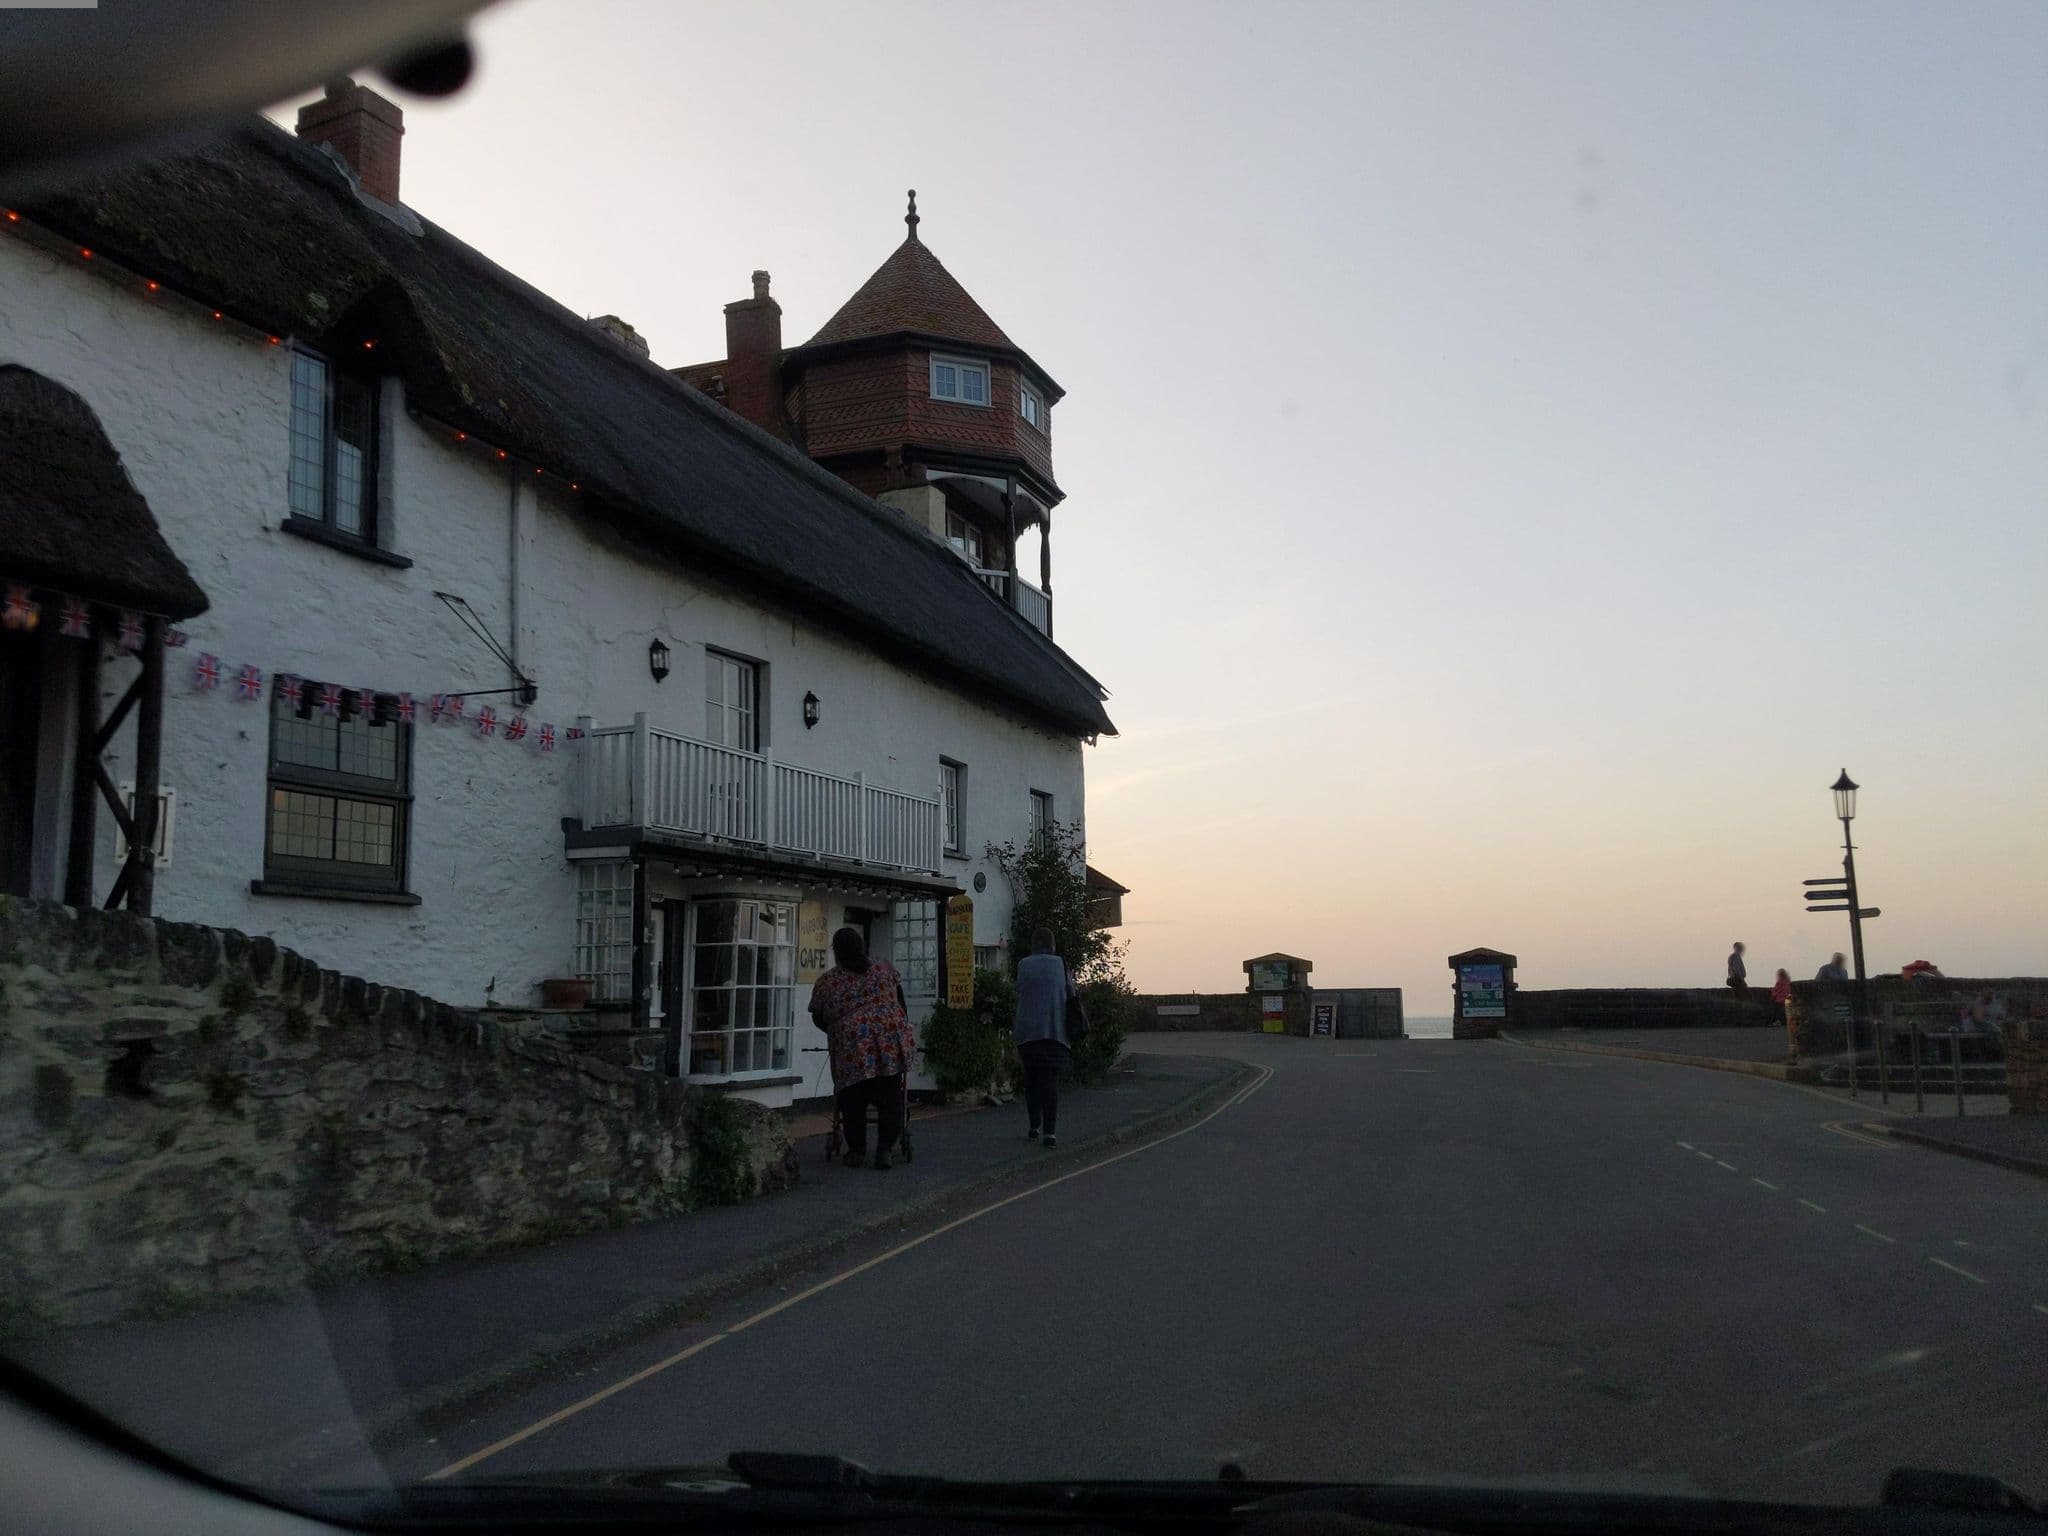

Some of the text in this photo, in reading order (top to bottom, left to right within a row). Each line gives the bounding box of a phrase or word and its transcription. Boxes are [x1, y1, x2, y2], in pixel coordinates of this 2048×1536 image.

[800, 947, 826, 968] CAFE
[951, 984, 969, 994] TAKE
[950, 994, 969, 1004] AWAY
